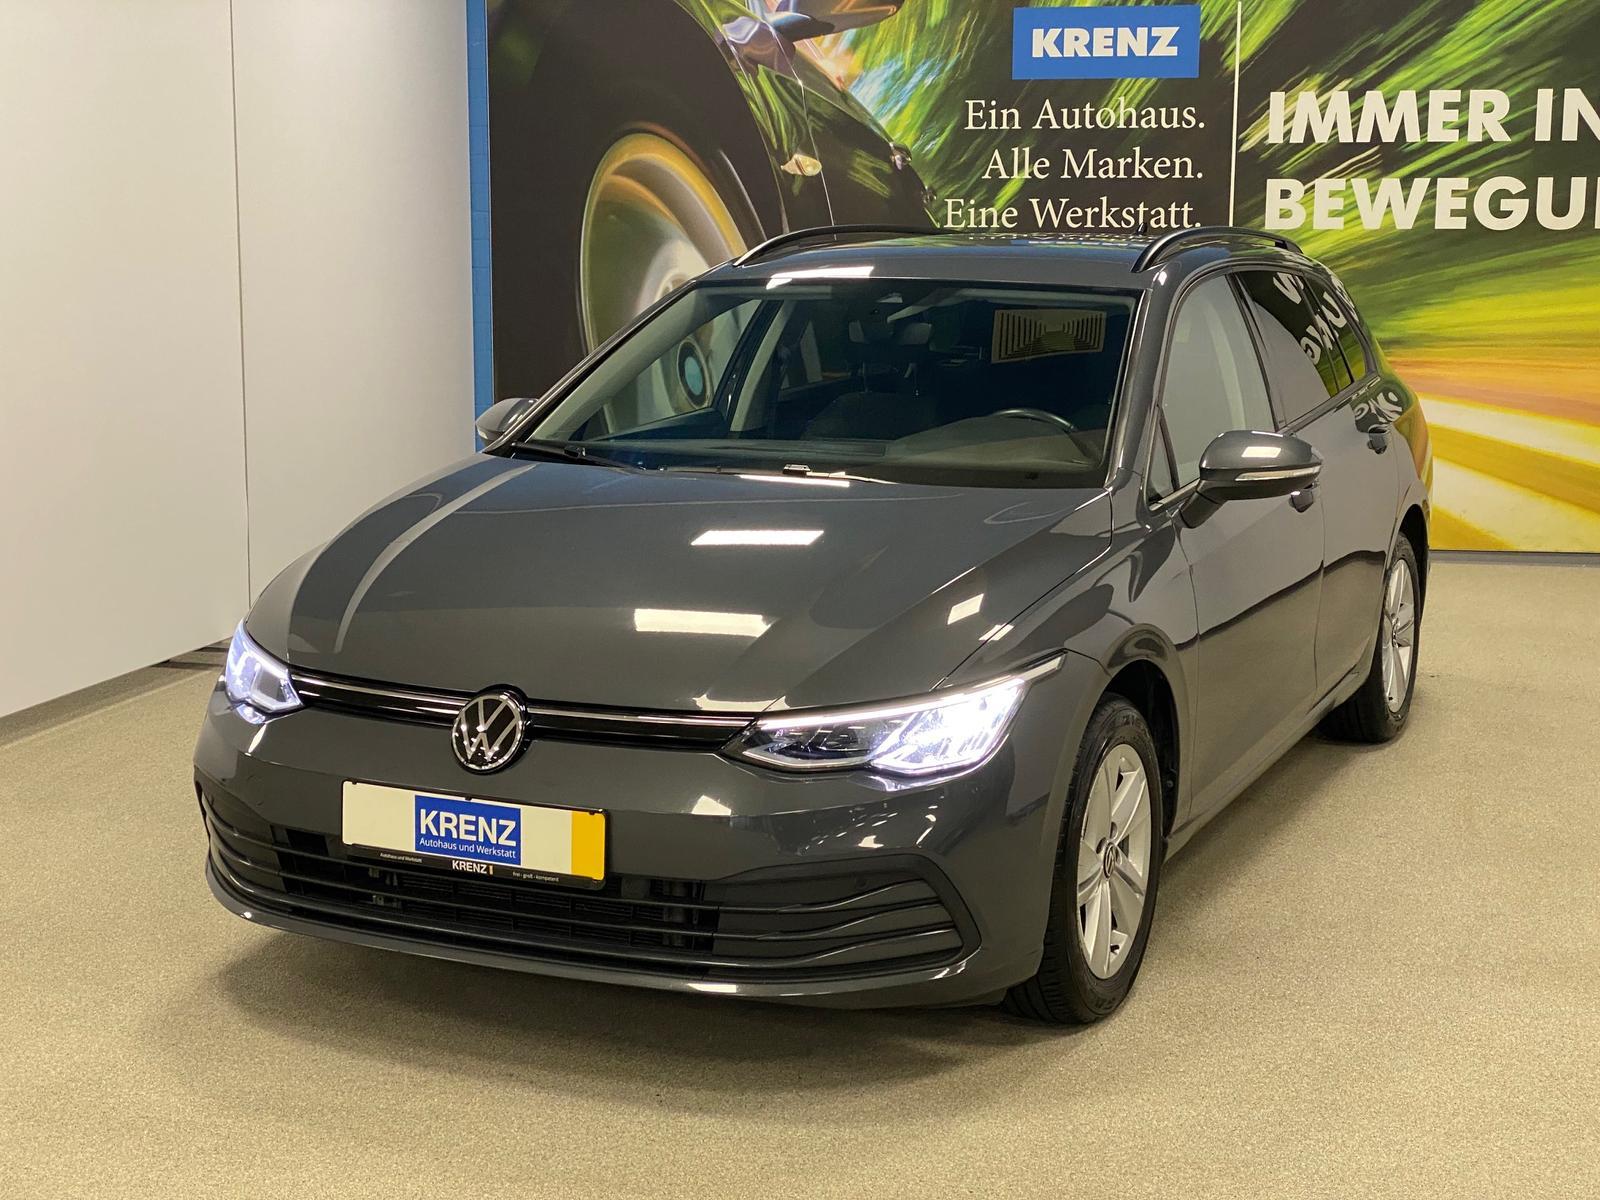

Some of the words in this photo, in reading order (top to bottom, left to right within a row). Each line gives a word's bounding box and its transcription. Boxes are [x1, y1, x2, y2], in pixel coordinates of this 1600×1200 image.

[1031, 26, 1180, 58] KRENZ
[963, 98, 1022, 130] Ein
[1031, 95, 1206, 130] Autohaus.
[1267, 88, 1512, 144] IMMER
[1534, 87, 1600, 142] IN
[982, 145, 1050, 180] Alle
[1060, 144, 1204, 179] Marken.
[943, 198, 1019, 228] Eine
[1028, 195, 1202, 229] Werkstatt.
[1264, 175, 1600, 231] BEWEGU
[420, 808, 517, 847] KRENZ
[419, 837, 457, 851] Autohaus
[458, 842, 475, 853] und
[475, 844, 517, 859] Werkstatt
[452, 859, 488, 874] KRENZ
